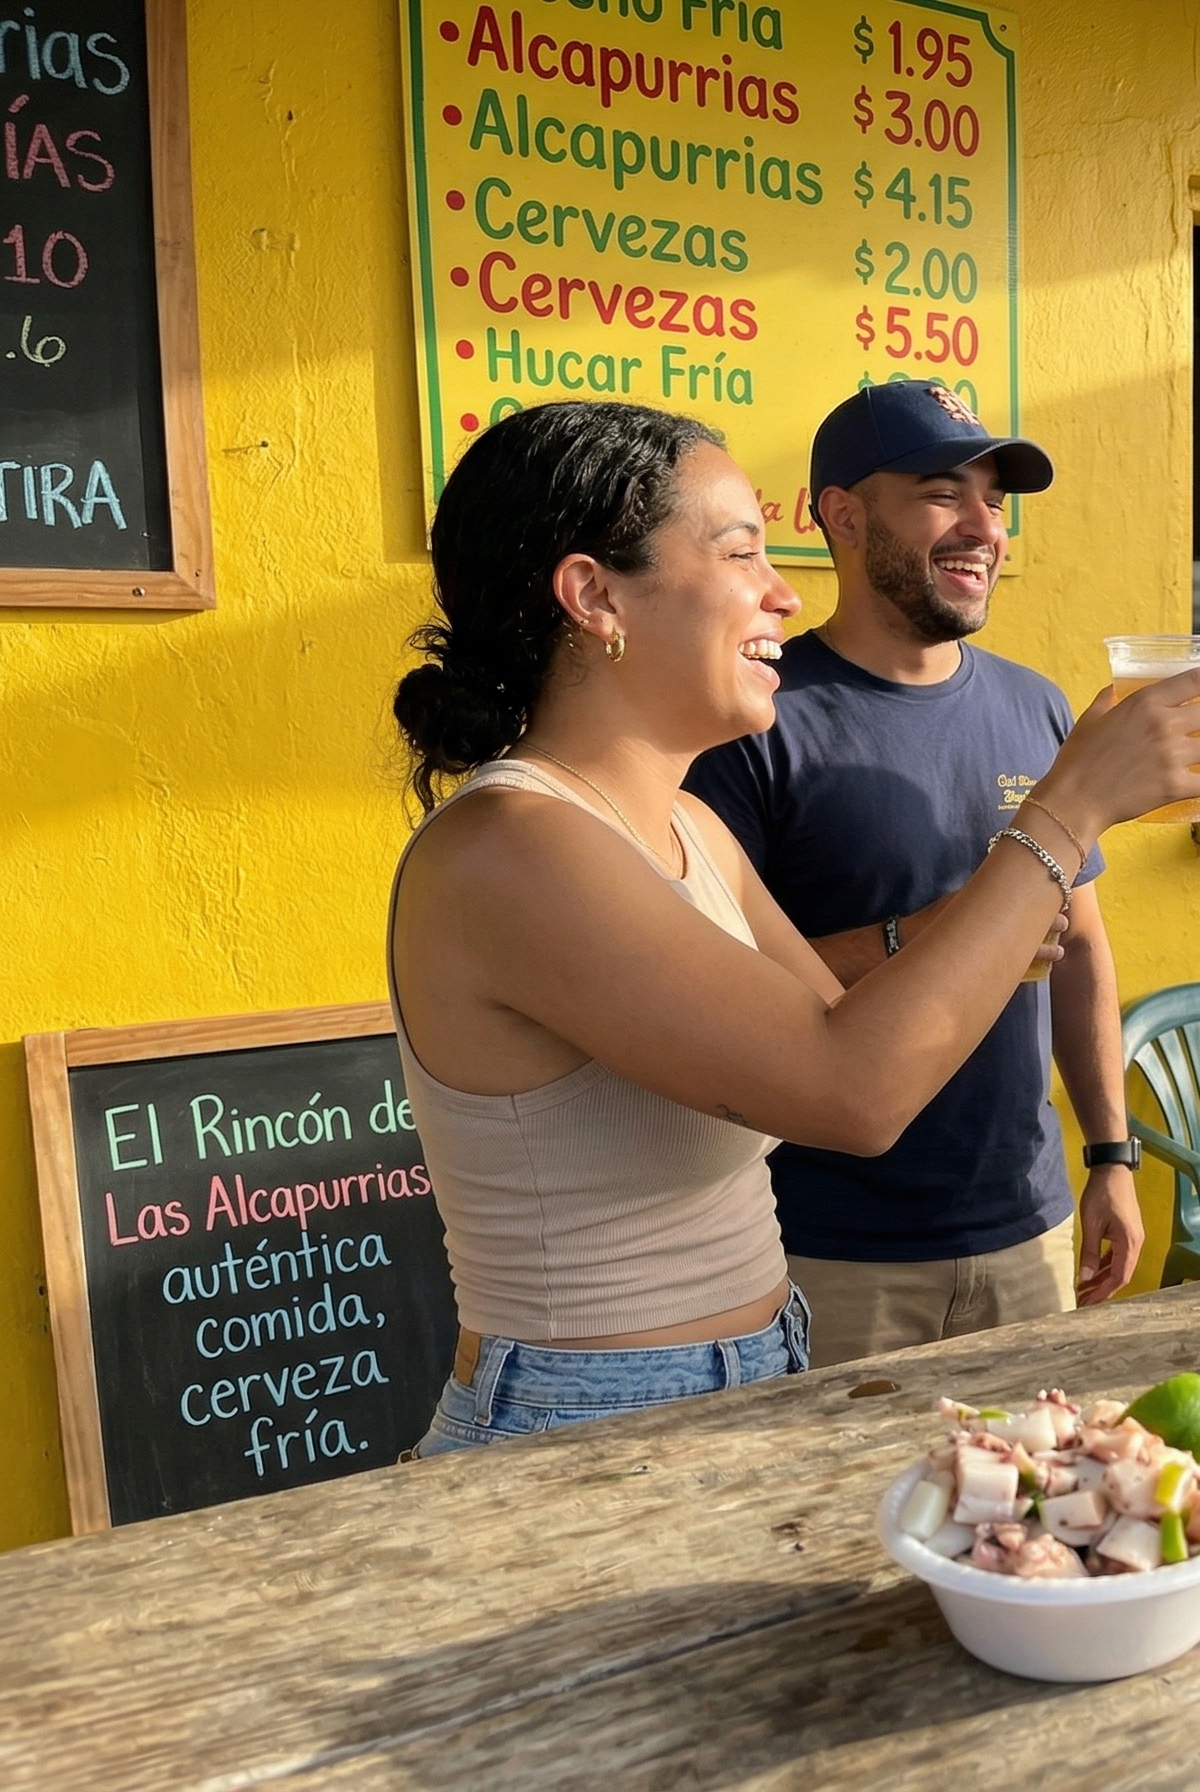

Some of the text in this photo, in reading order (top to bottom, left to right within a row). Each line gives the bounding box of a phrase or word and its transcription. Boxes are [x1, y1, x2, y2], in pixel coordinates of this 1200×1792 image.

[467, 5, 800, 125] Alcapurrias
[4, 94, 115, 192] ÍAS
[469, 88, 824, 206] Alcapurrias
[3, 224, 89, 289] 10
[474, 177, 749, 273] Cervezas
[478, 251, 759, 342] Cervezas
[486, 328, 754, 406] Hucar Fría
[104, 1079, 417, 1172] El Rincón de
[105, 1163, 431, 1247] Las Alcapurrias
[162, 1230, 392, 1305] auténtica
[195, 1282, 387, 1360] comida,
[179, 1348, 389, 1427] cerveza
[243, 1408, 370, 1477] fría.
